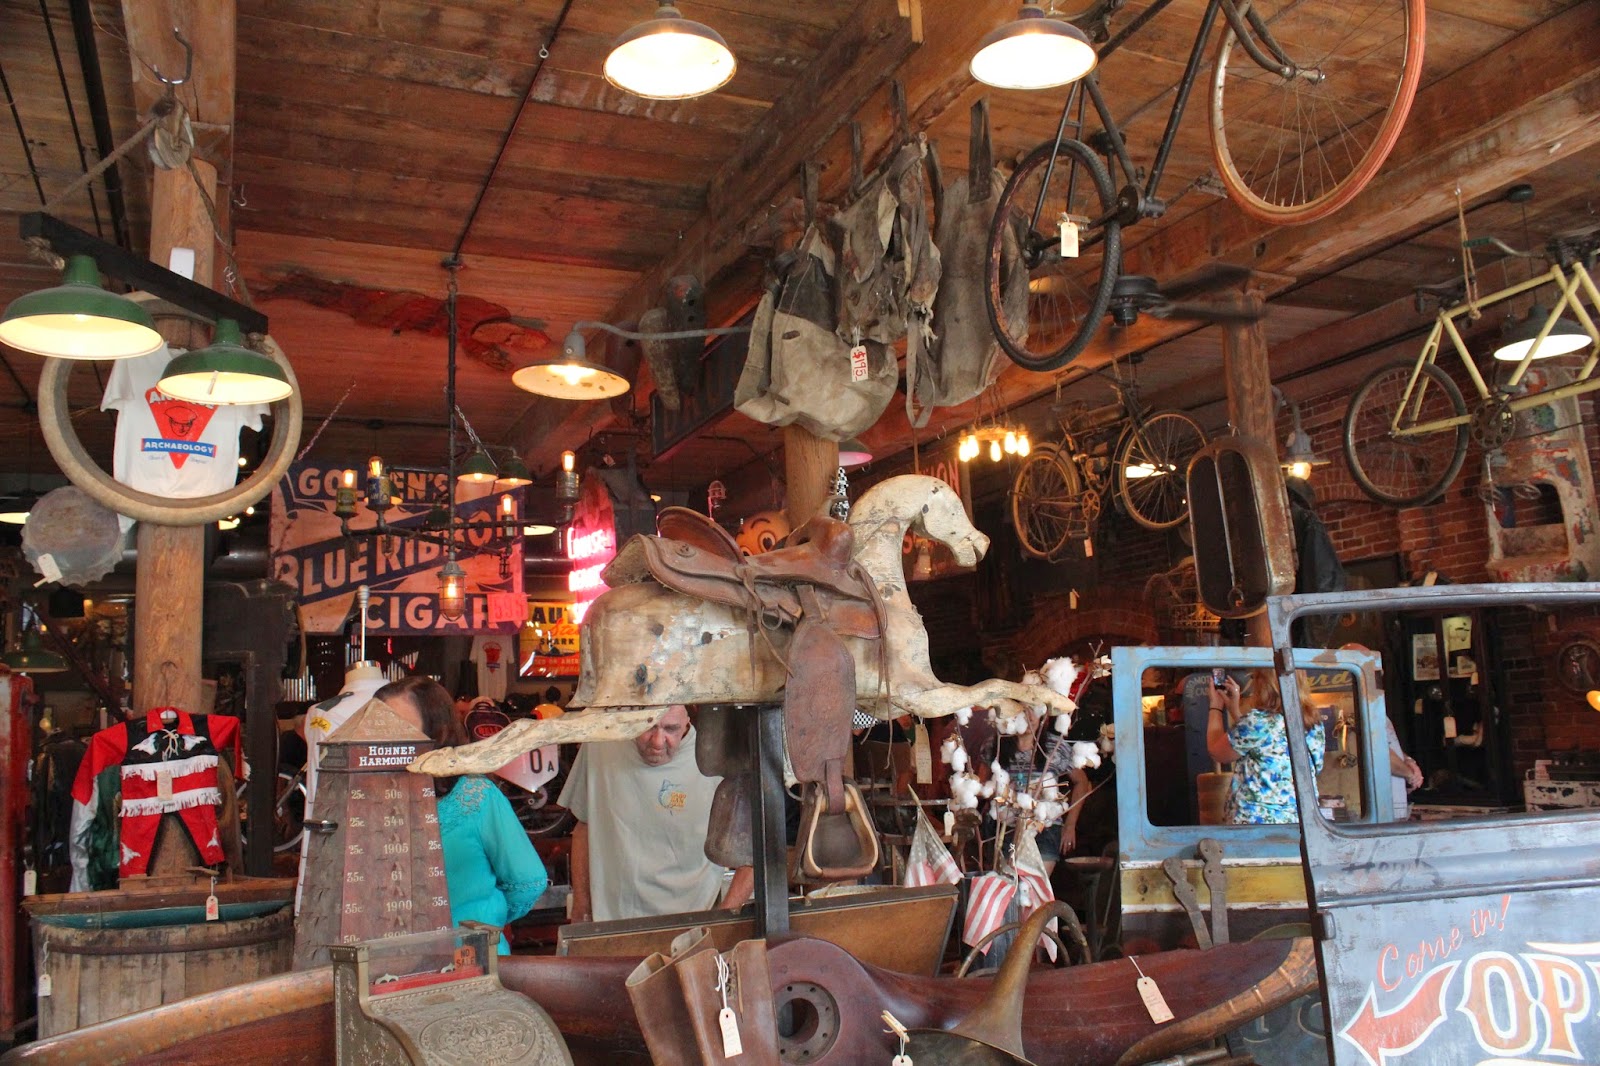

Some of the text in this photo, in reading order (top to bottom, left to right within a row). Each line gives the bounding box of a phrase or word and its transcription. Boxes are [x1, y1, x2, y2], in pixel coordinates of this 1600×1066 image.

[144, 441, 214, 454] ARCHAEOLOGY
[298, 467, 449, 501] GOLEN'S
[274, 538, 369, 598] BLUE
[539, 637, 575, 646] SHARK
[369, 746, 415, 756] HOHNER
[1377, 894, 1511, 992] Come in!
